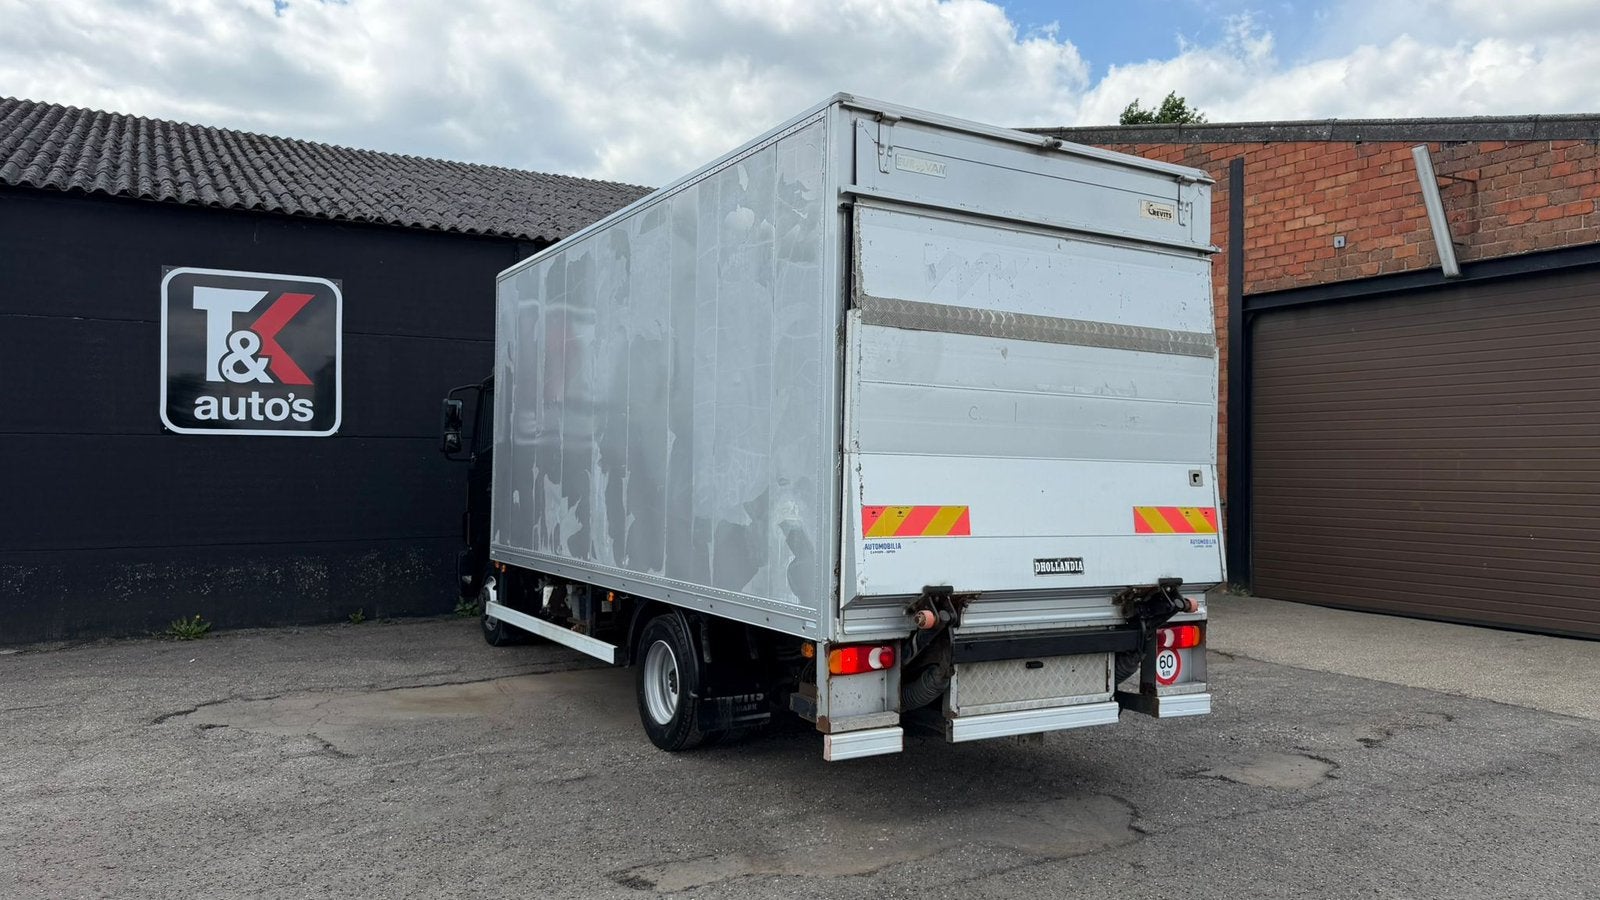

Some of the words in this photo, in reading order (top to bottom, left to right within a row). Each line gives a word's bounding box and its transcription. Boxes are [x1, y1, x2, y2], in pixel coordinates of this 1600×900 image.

[193, 391, 315, 422] auto's
[864, 542, 902, 550] AUTOMOBILIA
[1035, 560, 1084, 573] DHOLLANDIA
[1159, 654, 1174, 670] 60
